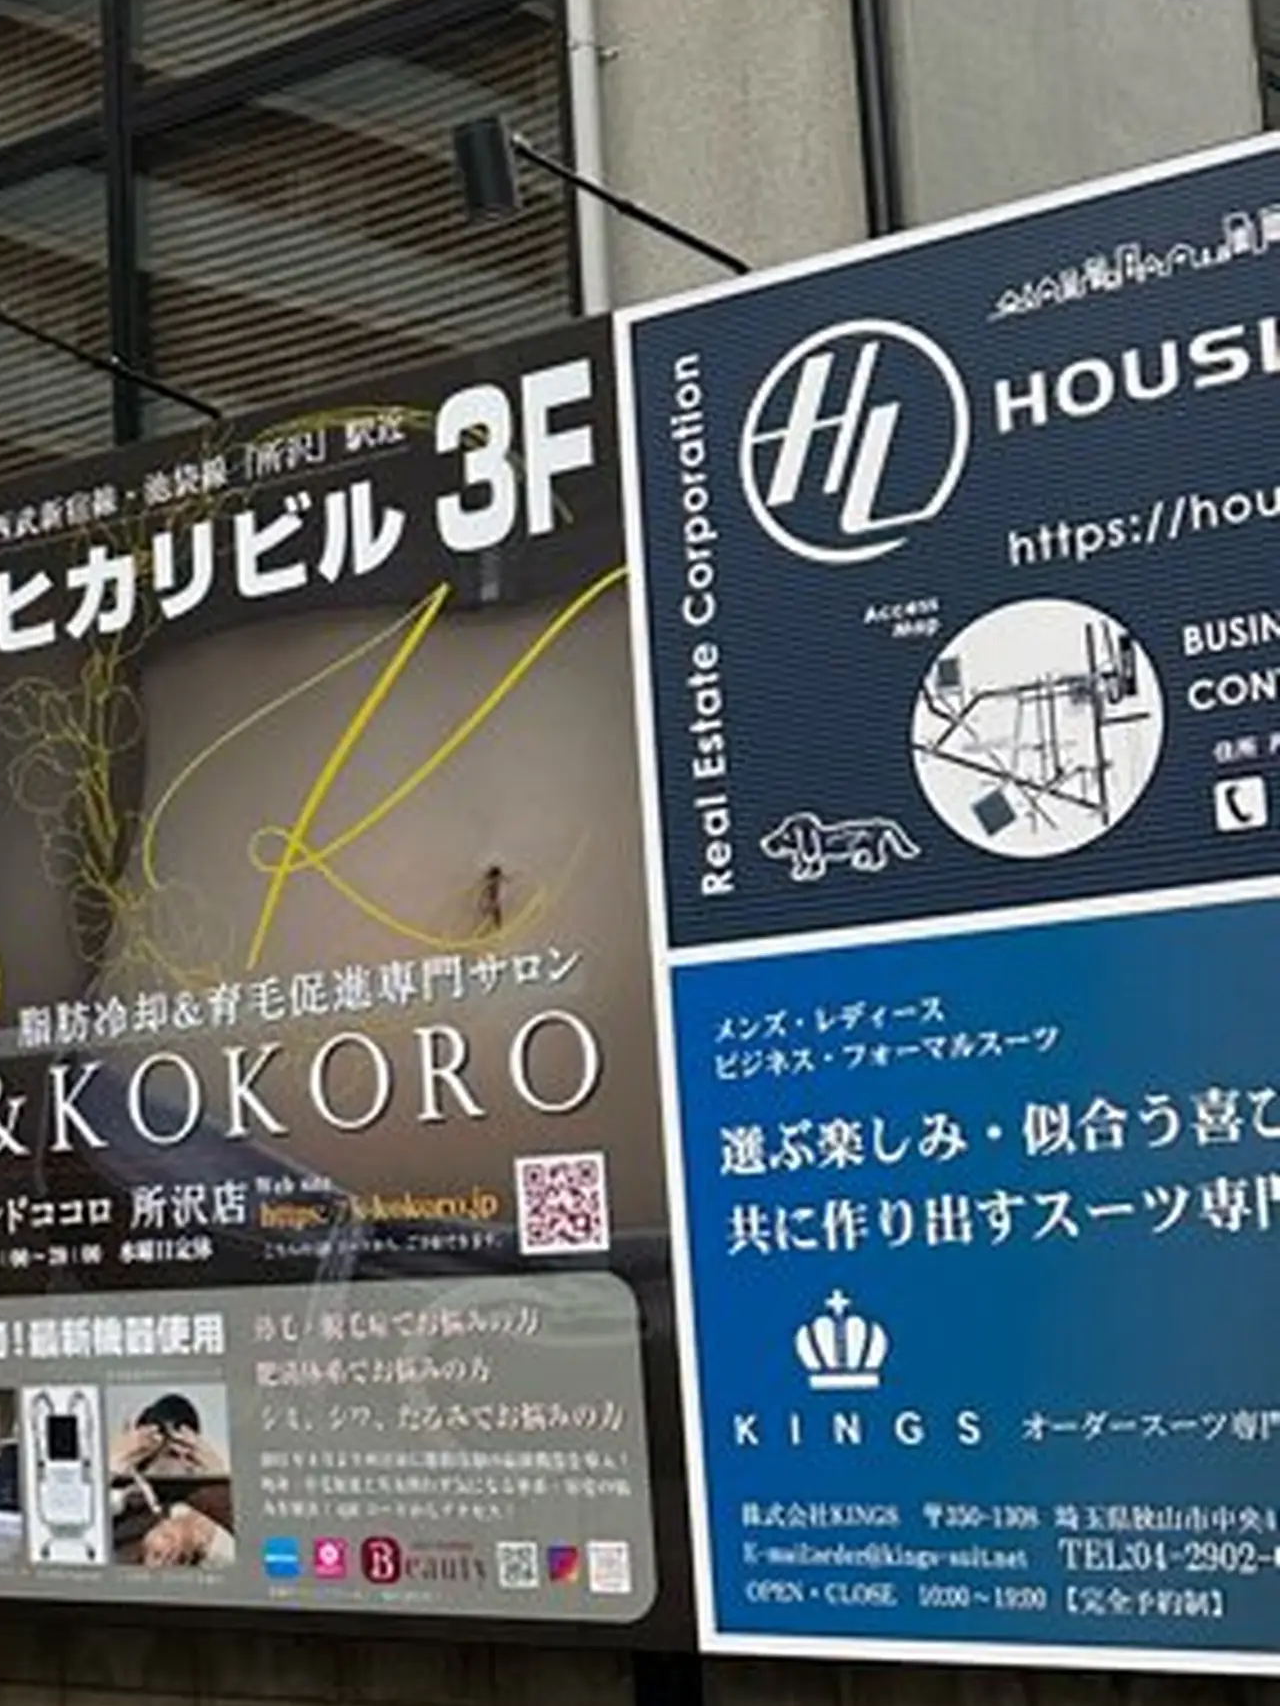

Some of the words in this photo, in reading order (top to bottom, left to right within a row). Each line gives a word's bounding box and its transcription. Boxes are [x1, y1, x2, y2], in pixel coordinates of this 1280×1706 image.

[435, 359, 595, 553] 3F
[671, 353, 718, 627] Corporation
[864, 597, 939, 623] Access
[687, 642, 727, 780] Estate
[1188, 668, 1280, 711] CON
[694, 794, 735, 895] Real
[714, 996, 945, 1045] メンズ・レディース
[715, 1026, 1060, 1081] ビジネス・フォーマルスーツ
[130, 1179, 249, 1229] 所沢店
[734, 1410, 982, 1446] KINGS
[1058, 1537, 1280, 1575] TEL:04-2902-
